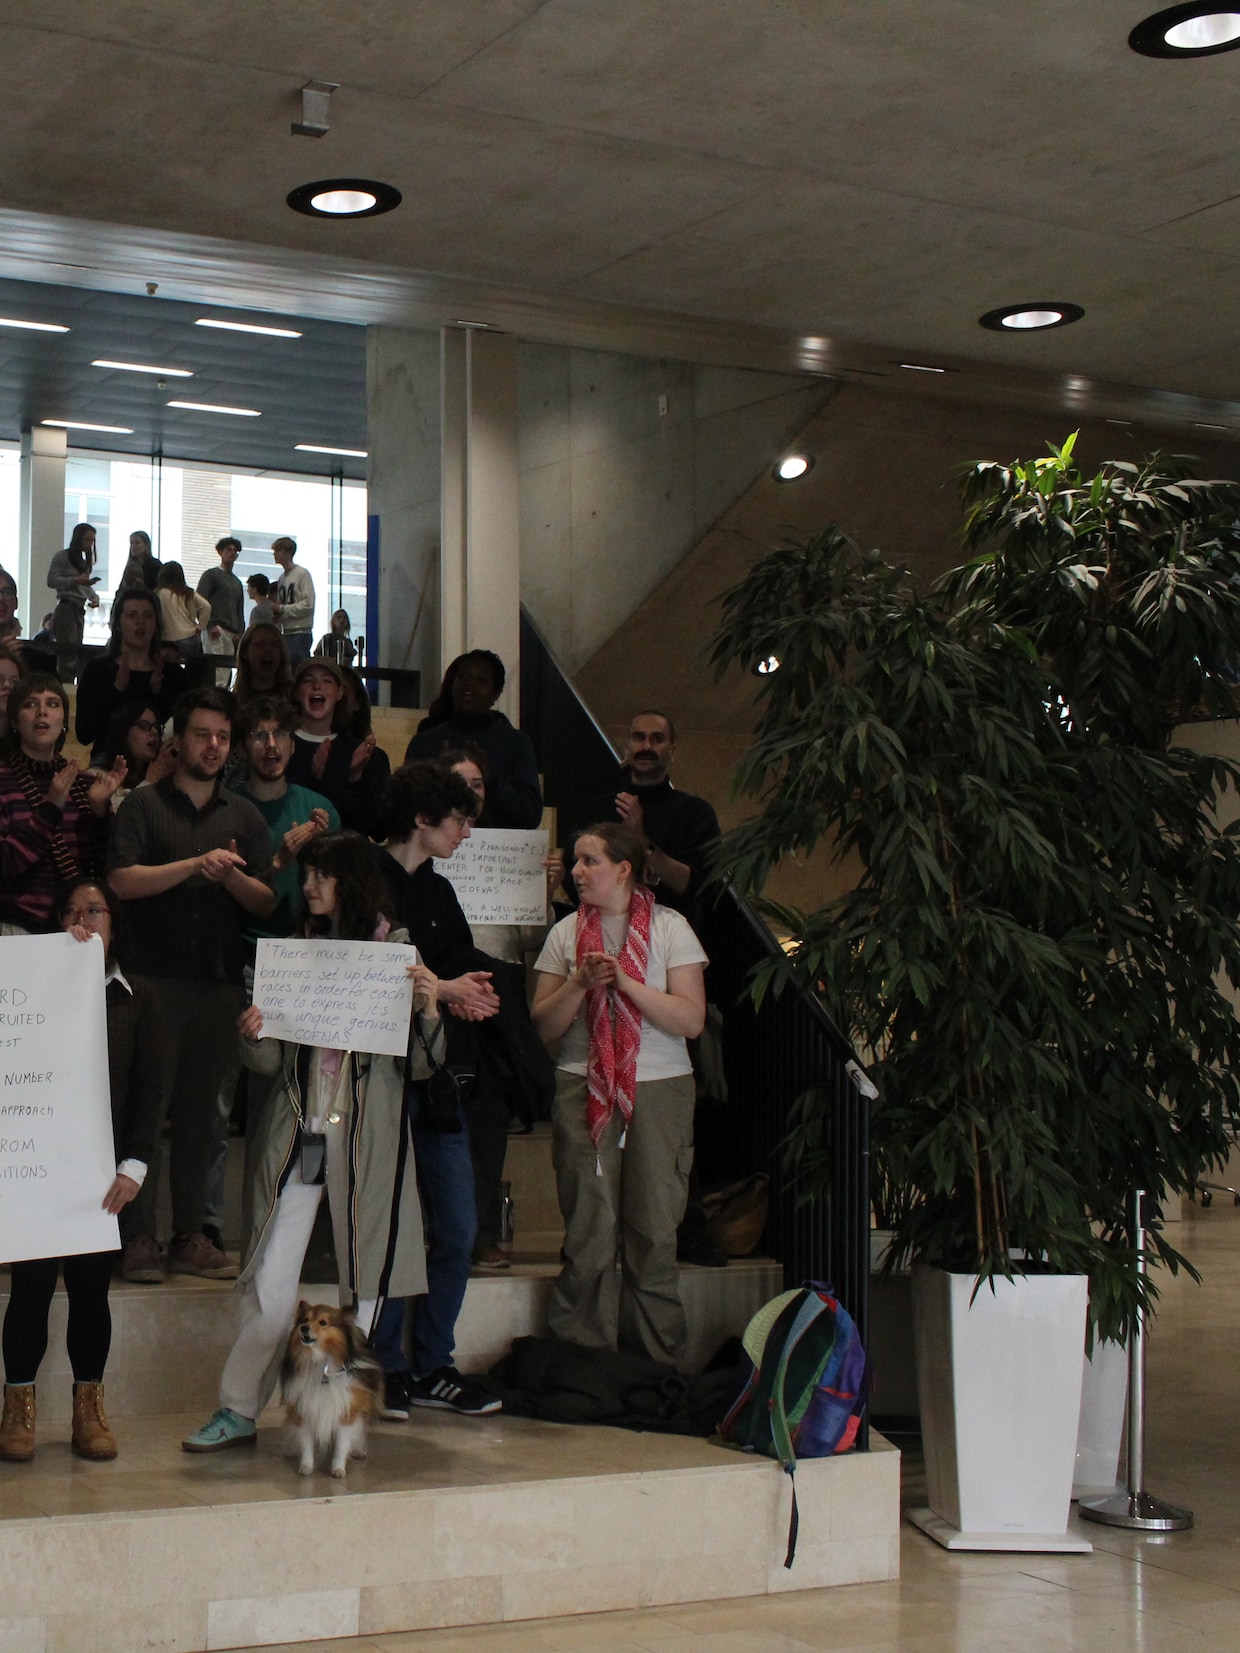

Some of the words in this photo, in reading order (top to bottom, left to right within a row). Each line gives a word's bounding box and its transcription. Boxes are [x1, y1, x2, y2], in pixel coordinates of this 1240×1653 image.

[434, 862, 467, 872] CENTER
[479, 864, 494, 873] FOR
[472, 854, 517, 864] IMPORTANT
[458, 885, 500, 894] COFNAS
[316, 948, 348, 960] must
[358, 947, 374, 961] be
[382, 953, 414, 964] some
[260, 964, 312, 979] barriers
[318, 967, 340, 980] set
[344, 970, 362, 984] up
[363, 967, 409, 984] between
[260, 983, 292, 993] races
[299, 983, 311, 993] in
[314, 983, 347, 996] order
[348, 981, 368, 998] for
[369, 987, 405, 1000] each
[263, 996, 285, 1008] one
[293, 995, 306, 1008] to
[311, 998, 358, 1012] express
[263, 1011, 286, 1021] own
[295, 1011, 340, 1030] unique
